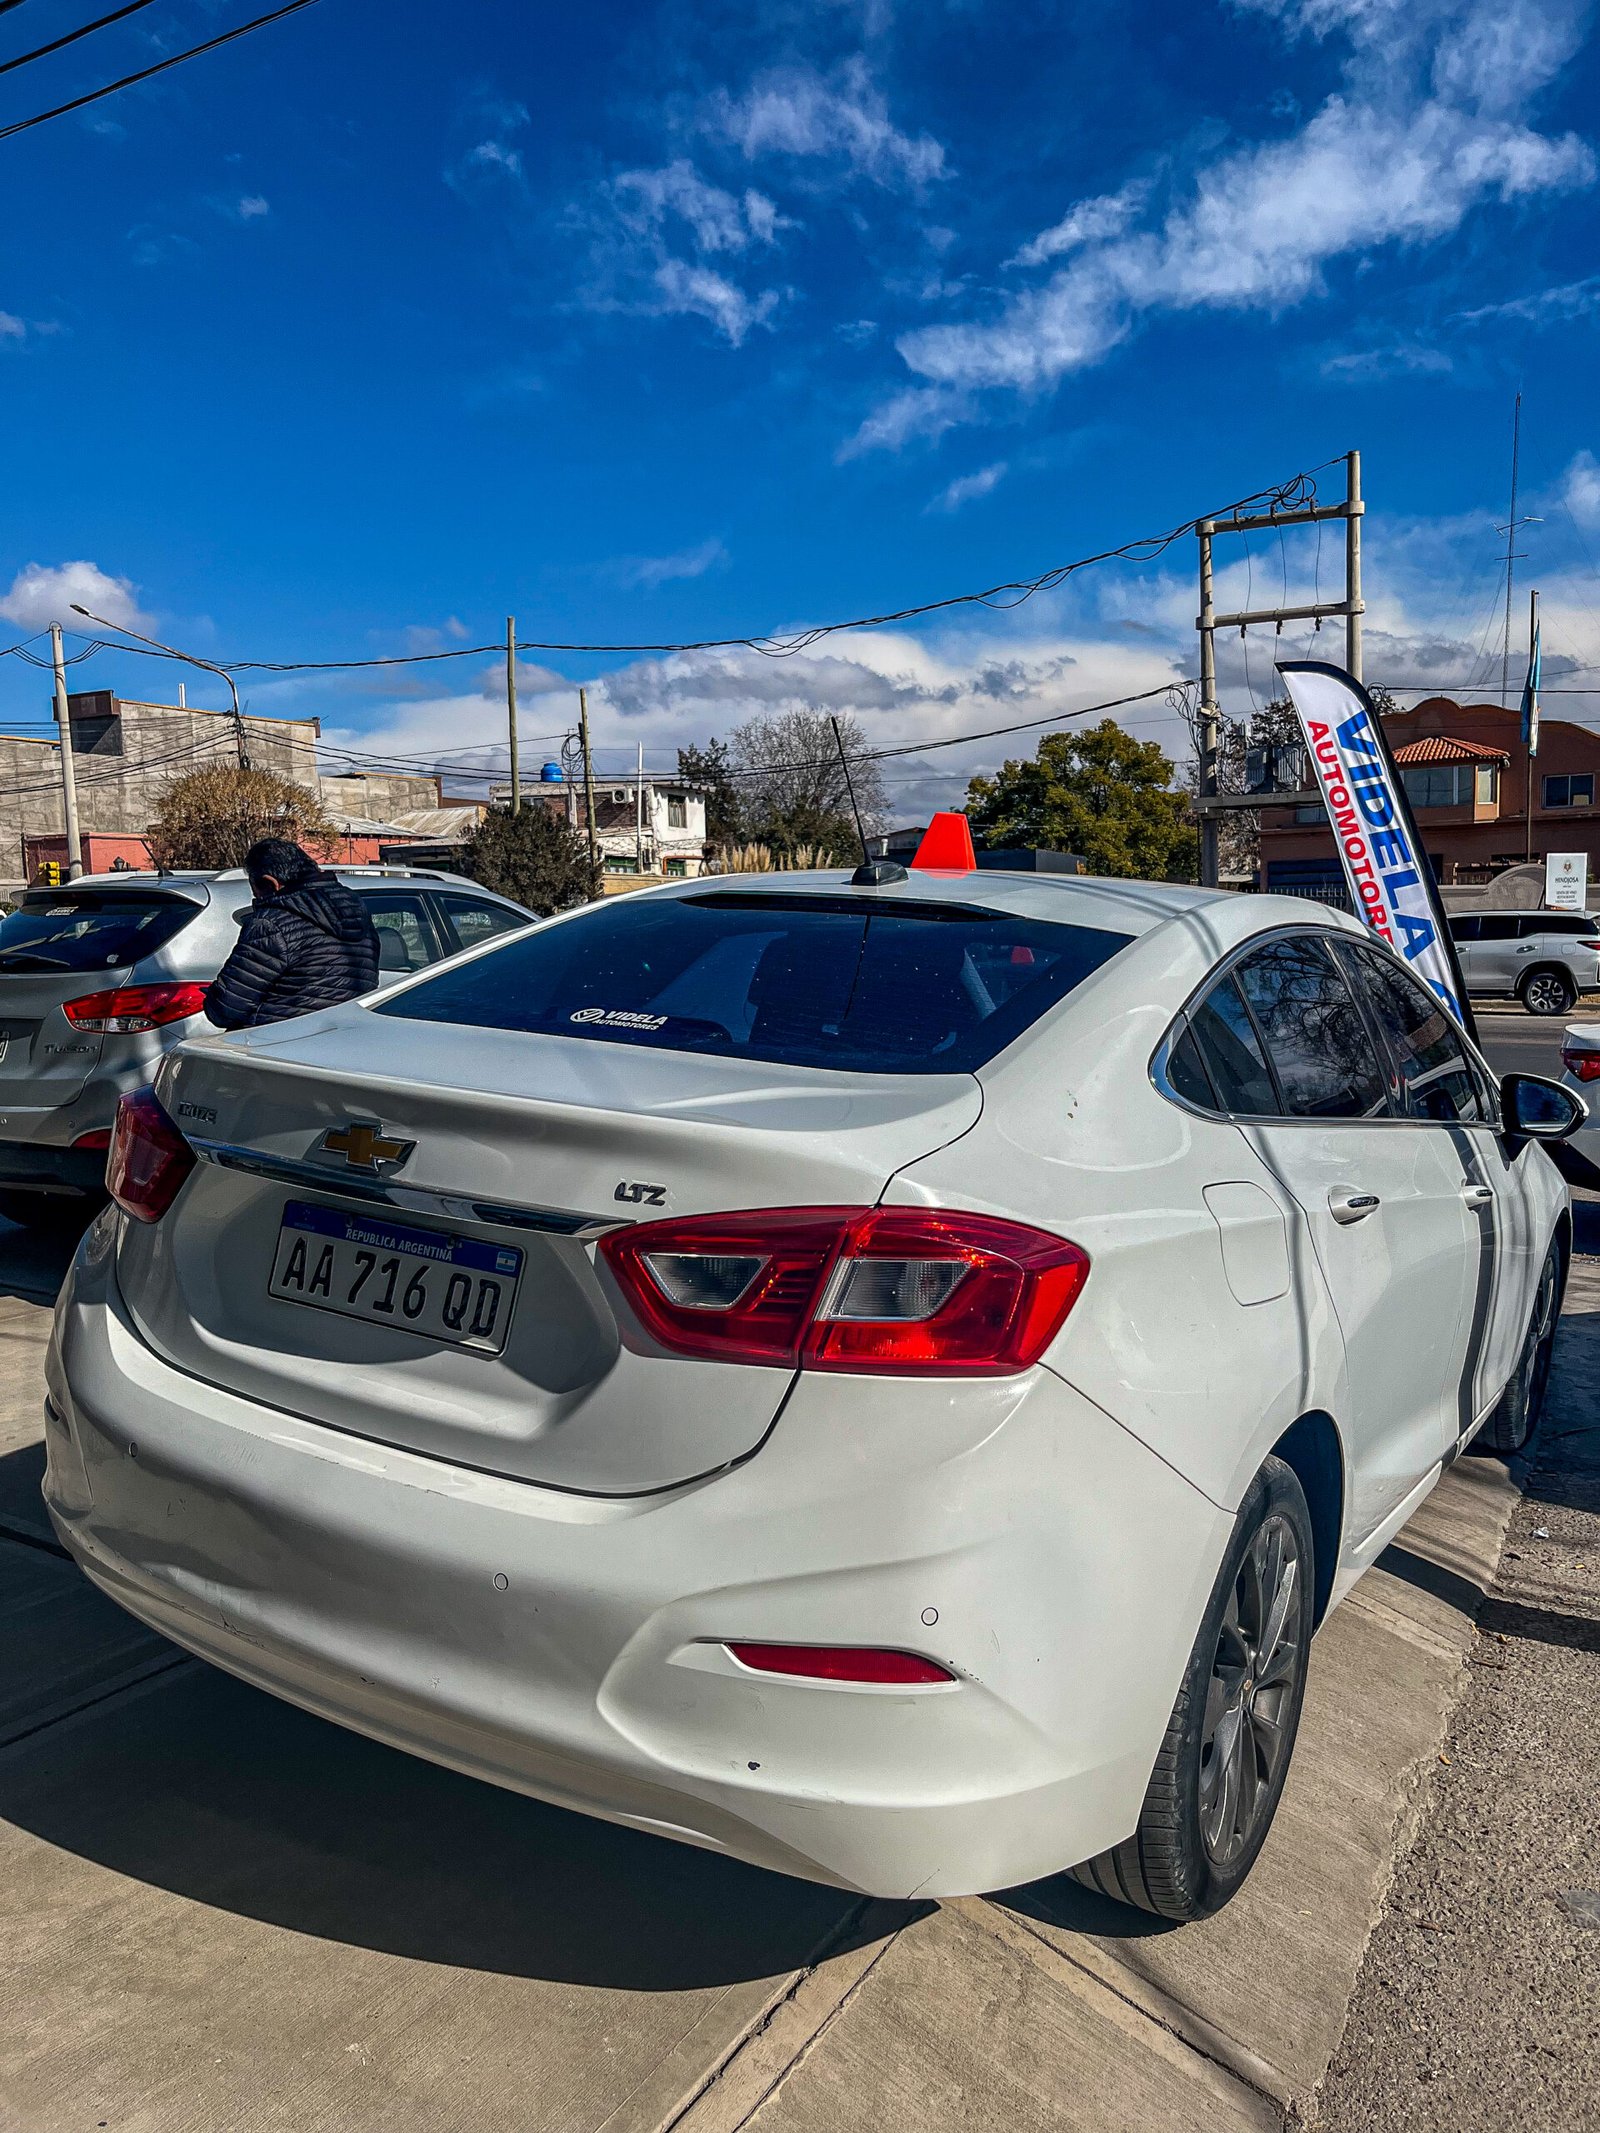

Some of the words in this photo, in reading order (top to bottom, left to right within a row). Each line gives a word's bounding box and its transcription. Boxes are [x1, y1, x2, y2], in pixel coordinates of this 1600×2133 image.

[1336, 710, 1436, 961] VIDELA
[592, 1019, 659, 1030] AUTOMOTORES
[605, 1010, 668, 1025] VIDELA
[614, 1179, 667, 1206] LTZ
[345, 1228, 396, 1250] REPUBLICA
[397, 1239, 452, 1261] ARGENTINA
[281, 1236, 334, 1298] AA
[347, 1250, 431, 1320] 716
[442, 1272, 501, 1338] QD
